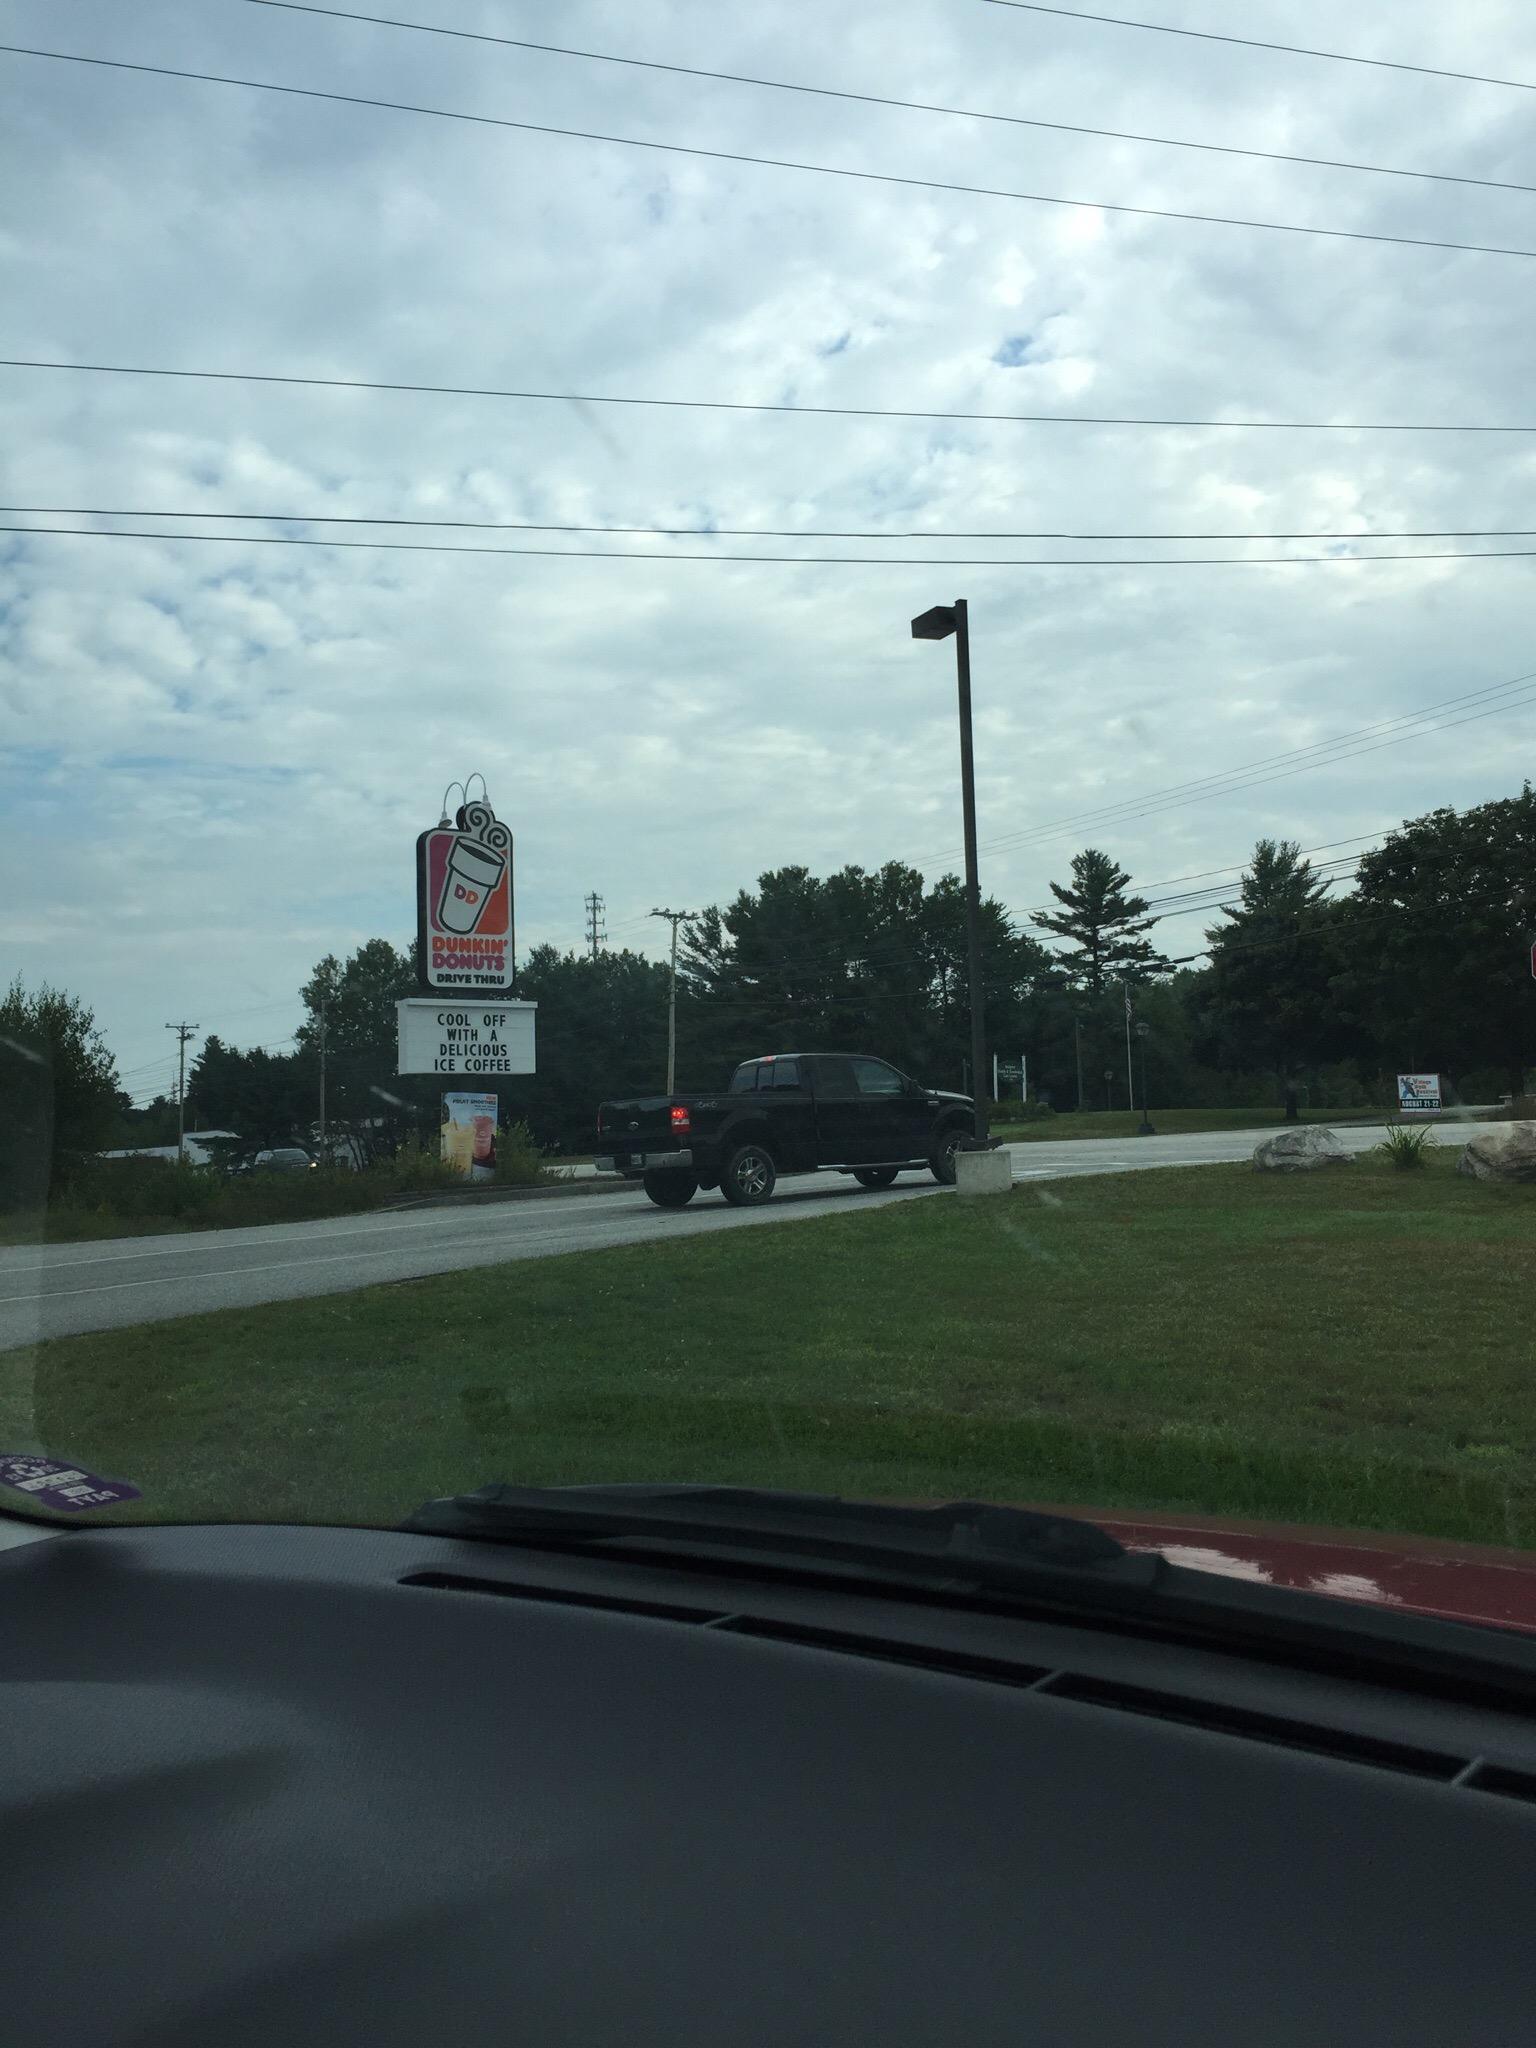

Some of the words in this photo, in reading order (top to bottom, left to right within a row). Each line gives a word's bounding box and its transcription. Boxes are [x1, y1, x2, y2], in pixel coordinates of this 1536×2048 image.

[454, 883, 478, 905] DD
[432, 936, 509, 954] DUNKIN'
[432, 953, 505, 971] DONUTS
[436, 974, 471, 984] DRIVE
[473, 974, 505, 984] THRU
[437, 1014, 471, 1026] COOL
[483, 1014, 506, 1027] OFF
[447, 1029, 479, 1041] WITH
[490, 1029, 498, 1041] A
[439, 1044, 507, 1056] DELICIOUS
[434, 1059, 455, 1071] ICE
[464, 1059, 511, 1071] COFFEE
